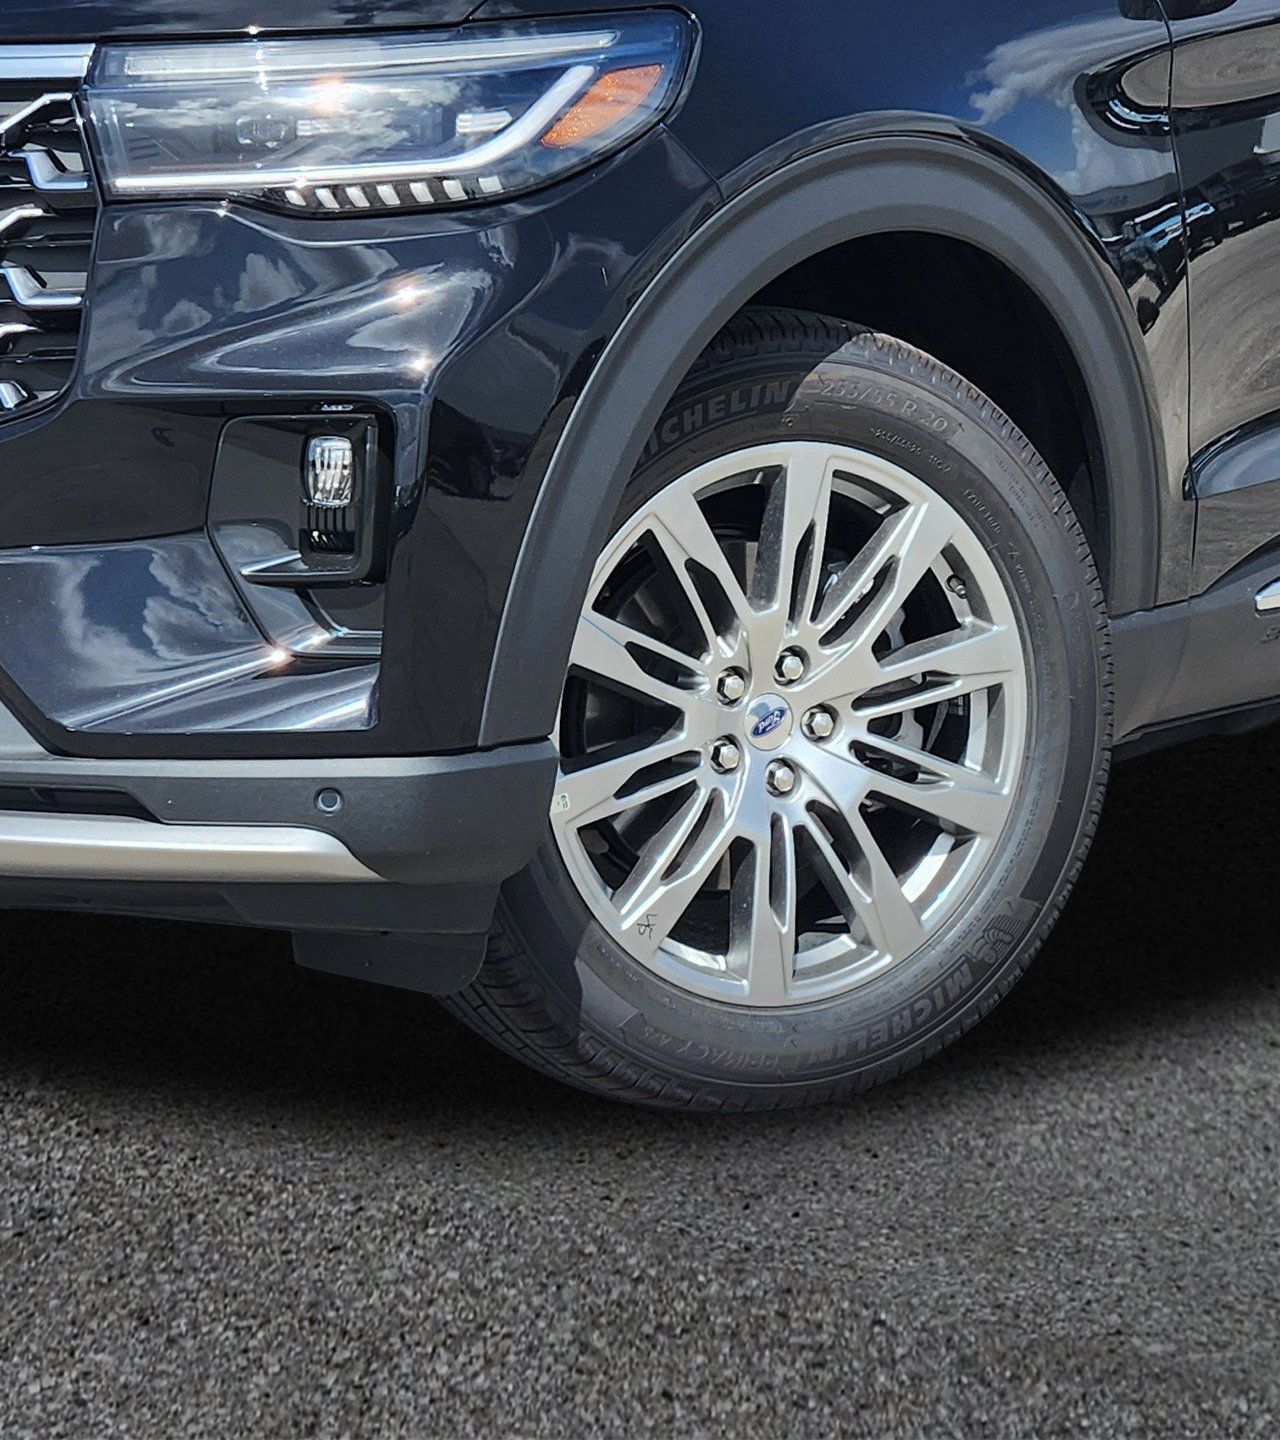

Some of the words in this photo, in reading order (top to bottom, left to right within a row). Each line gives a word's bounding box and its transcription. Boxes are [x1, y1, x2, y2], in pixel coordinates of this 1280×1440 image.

[647, 380, 794, 458] ICHELIN
[901, 399, 918, 417] R
[920, 410, 948, 433] 20
[757, 709, 781, 734] Ford
[800, 962, 974, 1066] MICHELIN
